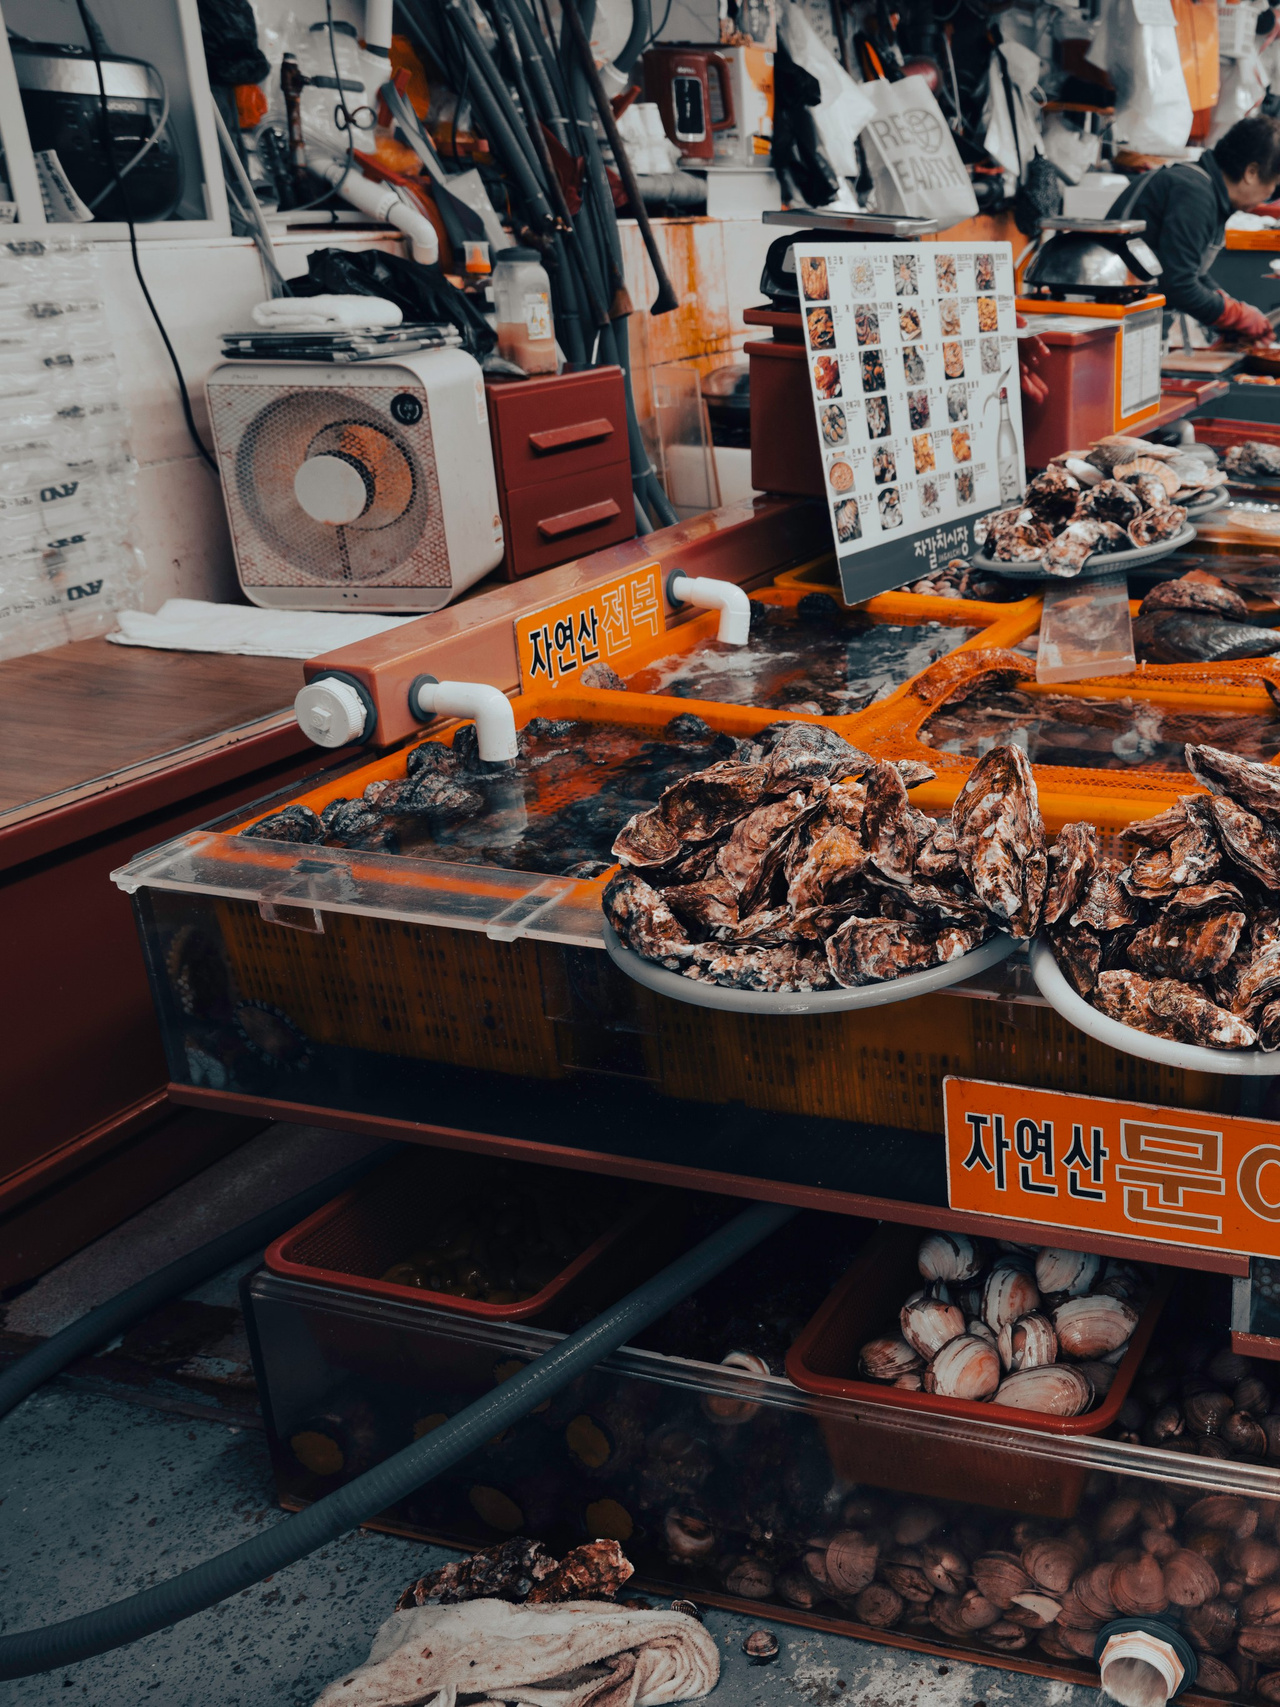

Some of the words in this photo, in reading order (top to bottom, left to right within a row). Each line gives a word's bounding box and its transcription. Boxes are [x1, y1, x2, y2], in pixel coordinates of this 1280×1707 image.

[892, 155, 966, 195] EARTH
[914, 526, 969, 569] 자갈치시장
[529, 605, 600, 681] 자연산
[601, 574, 659, 657] 전복
[960, 1110, 1108, 1203] 자연산
